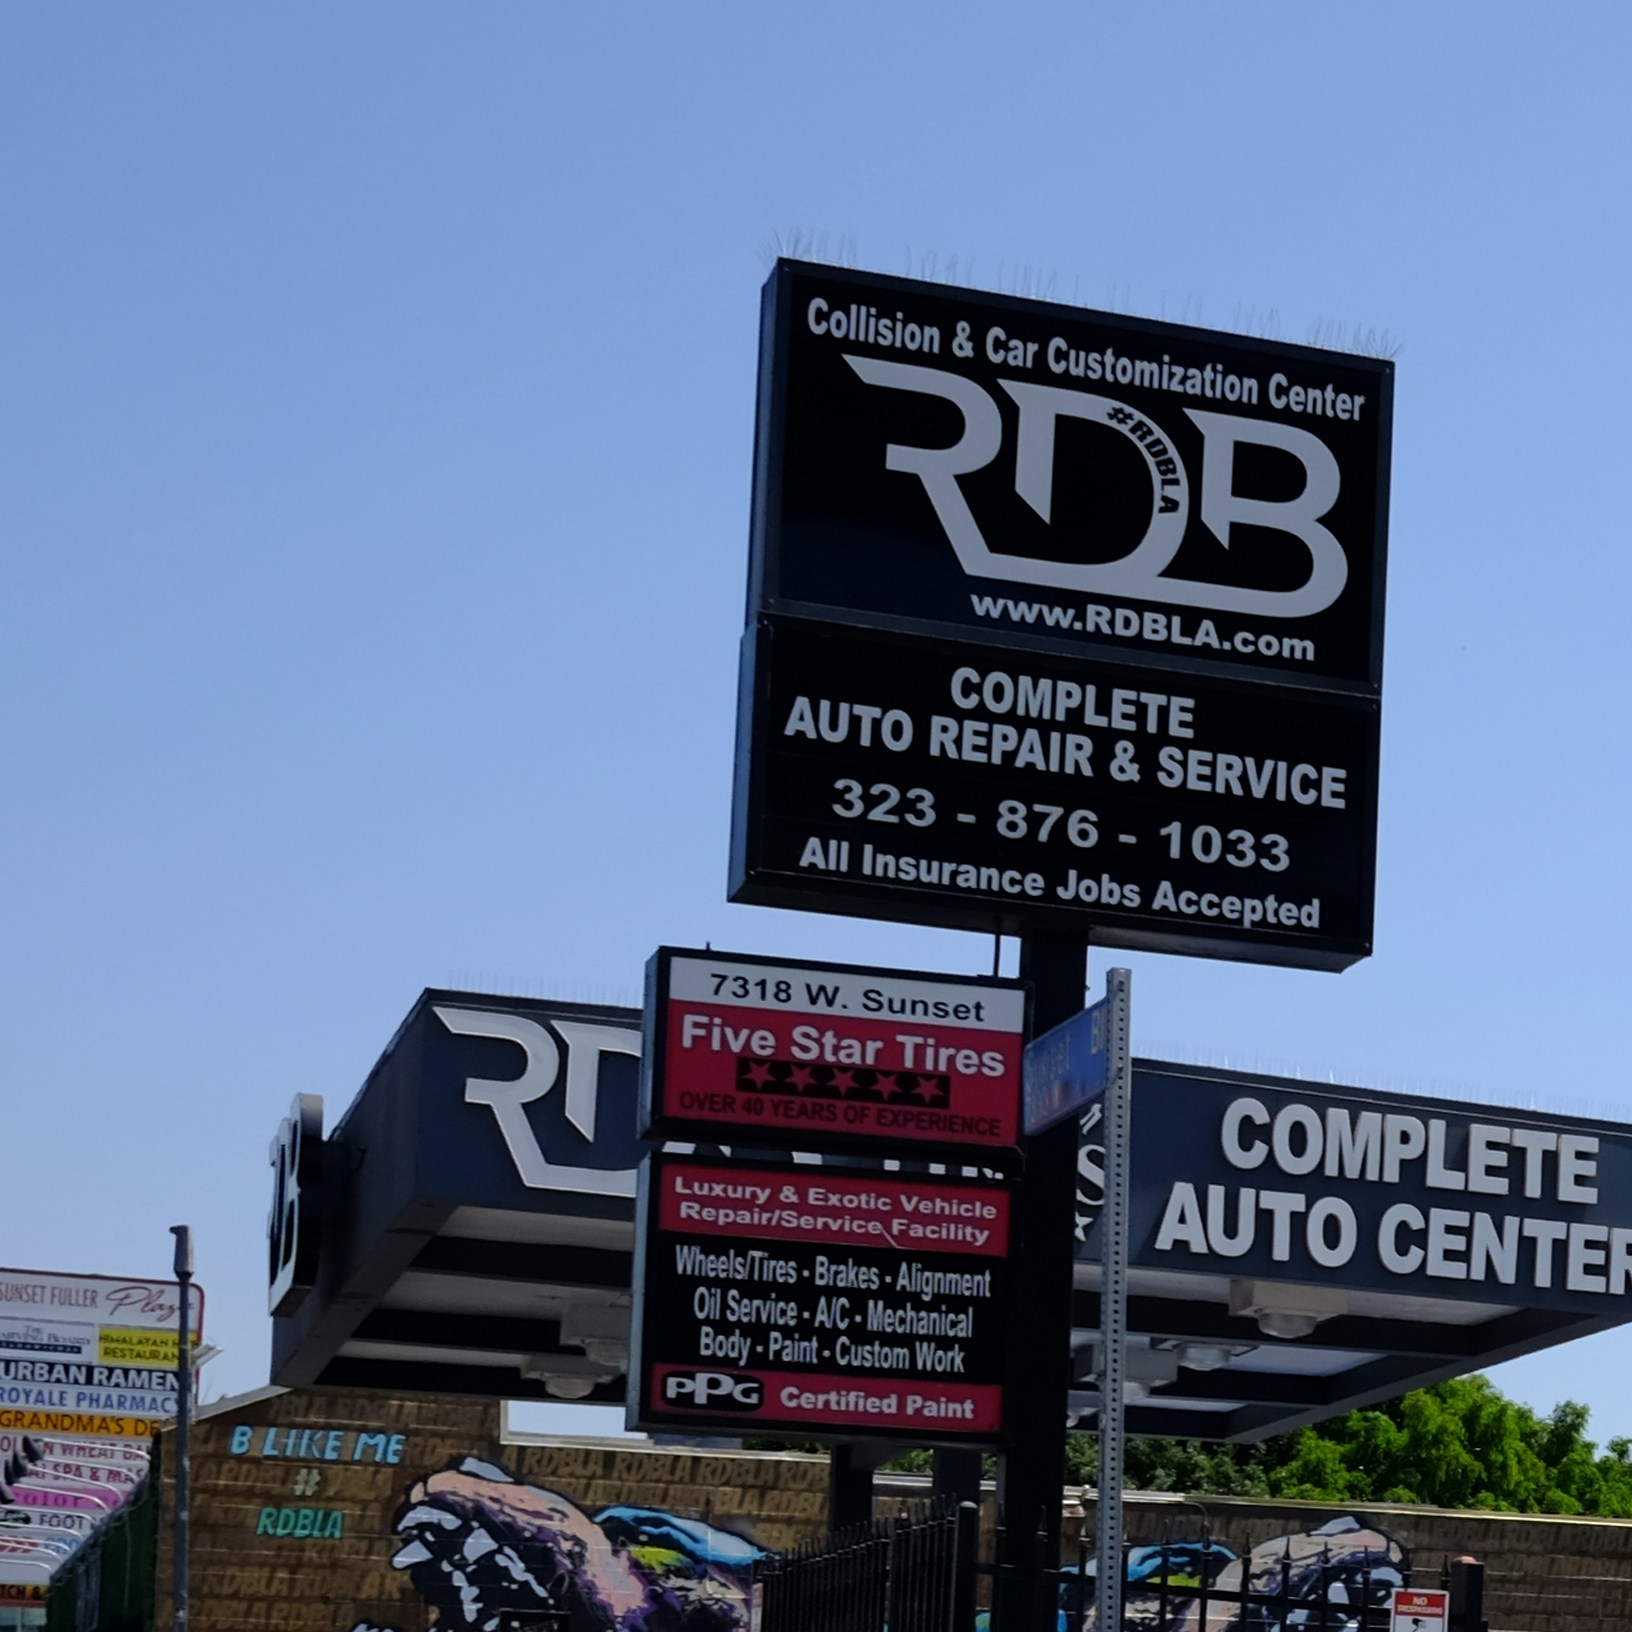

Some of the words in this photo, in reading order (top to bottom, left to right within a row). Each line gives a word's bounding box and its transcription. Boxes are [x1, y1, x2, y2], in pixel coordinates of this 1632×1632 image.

[808, 297, 940, 357] Collision
[952, 322, 974, 357] &
[986, 328, 1039, 370] Car
[1048, 337, 1258, 405] Customization
[1268, 373, 1366, 422] Center
[1107, 405, 1182, 515] #RDBLA
[841, 353, 1349, 619] RDB
[971, 593, 1315, 661] www.RDBLA.com
[951, 666, 1196, 739] COMPLETE
[784, 696, 913, 752] AUTO
[930, 721, 1093, 777] REPAIR
[1109, 738, 1140, 783] &
[1157, 745, 1347, 810] SERVICE
[832, 778, 936, 828] 323
[997, 799, 1100, 848] 876
[1159, 820, 1291, 872] 1033
[799, 836, 849, 873] All
[861, 844, 1045, 897] Insurance
[1056, 868, 1141, 911] Jobs
[1151, 881, 1320, 930] Accepted
[709, 973, 792, 1003] 7318
[805, 983, 848, 1010] W.
[861, 989, 985, 1023] Sunset
[681, 1014, 776, 1056] Five
[790, 1025, 884, 1065] Star
[895, 1034, 1006, 1077] Tires
[679, 1090, 738, 1115] OVER
[741, 1094, 765, 1116] 40
[769, 1096, 838, 1123] YEARS
[844, 1104, 870, 1126] OF
[876, 1108, 1001, 1138] EXPERIENCE
[1221, 1097, 1598, 1204] COMPLETE
[674, 1176, 772, 1204] Luxury
[779, 1184, 800, 1204] &
[807, 1187, 892, 1212] Exotic
[899, 1194, 998, 1220] Vehicle
[679, 1201, 882, 1236] Repair/Service
[891, 1217, 990, 1247] Facility
[1155, 1181, 1358, 1268] AUTO
[675, 1244, 798, 1284] Wheels/Tires
[814, 1255, 881, 1291] Brakes
[896, 1260, 992, 1301] Alignment
[0, 1282, 46, 1304] SUNSET
[50, 1287, 99, 1309] FULLER
[105, 1286, 181, 1322] Plaz
[693, 1286, 721, 1321] Oil
[726, 1289, 798, 1327] Service
[814, 1295, 851, 1331] A/C
[866, 1299, 974, 1339] Mechanical
[103, 1346, 180, 1362] RESTAURAN
[698, 1326, 751, 1367] Body
[768, 1330, 819, 1366] Paint
[835, 1336, 910, 1371] Custom
[914, 1341, 966, 1375] Work
[0, 1361, 87, 1385] URBAN
[93, 1368, 180, 1391] RAMEN
[0, 1386, 68, 1407] ROYALE
[665, 1372, 760, 1405] PPG
[0, 1410, 125, 1435] GRANDMA'S
[779, 1385, 898, 1417] Certified
[904, 1389, 975, 1420] Paint
[229, 1424, 253, 1455] B
[262, 1426, 344, 1461] LIKE
[352, 1431, 408, 1465] ME
[256, 1506, 343, 1539] RDBLA
